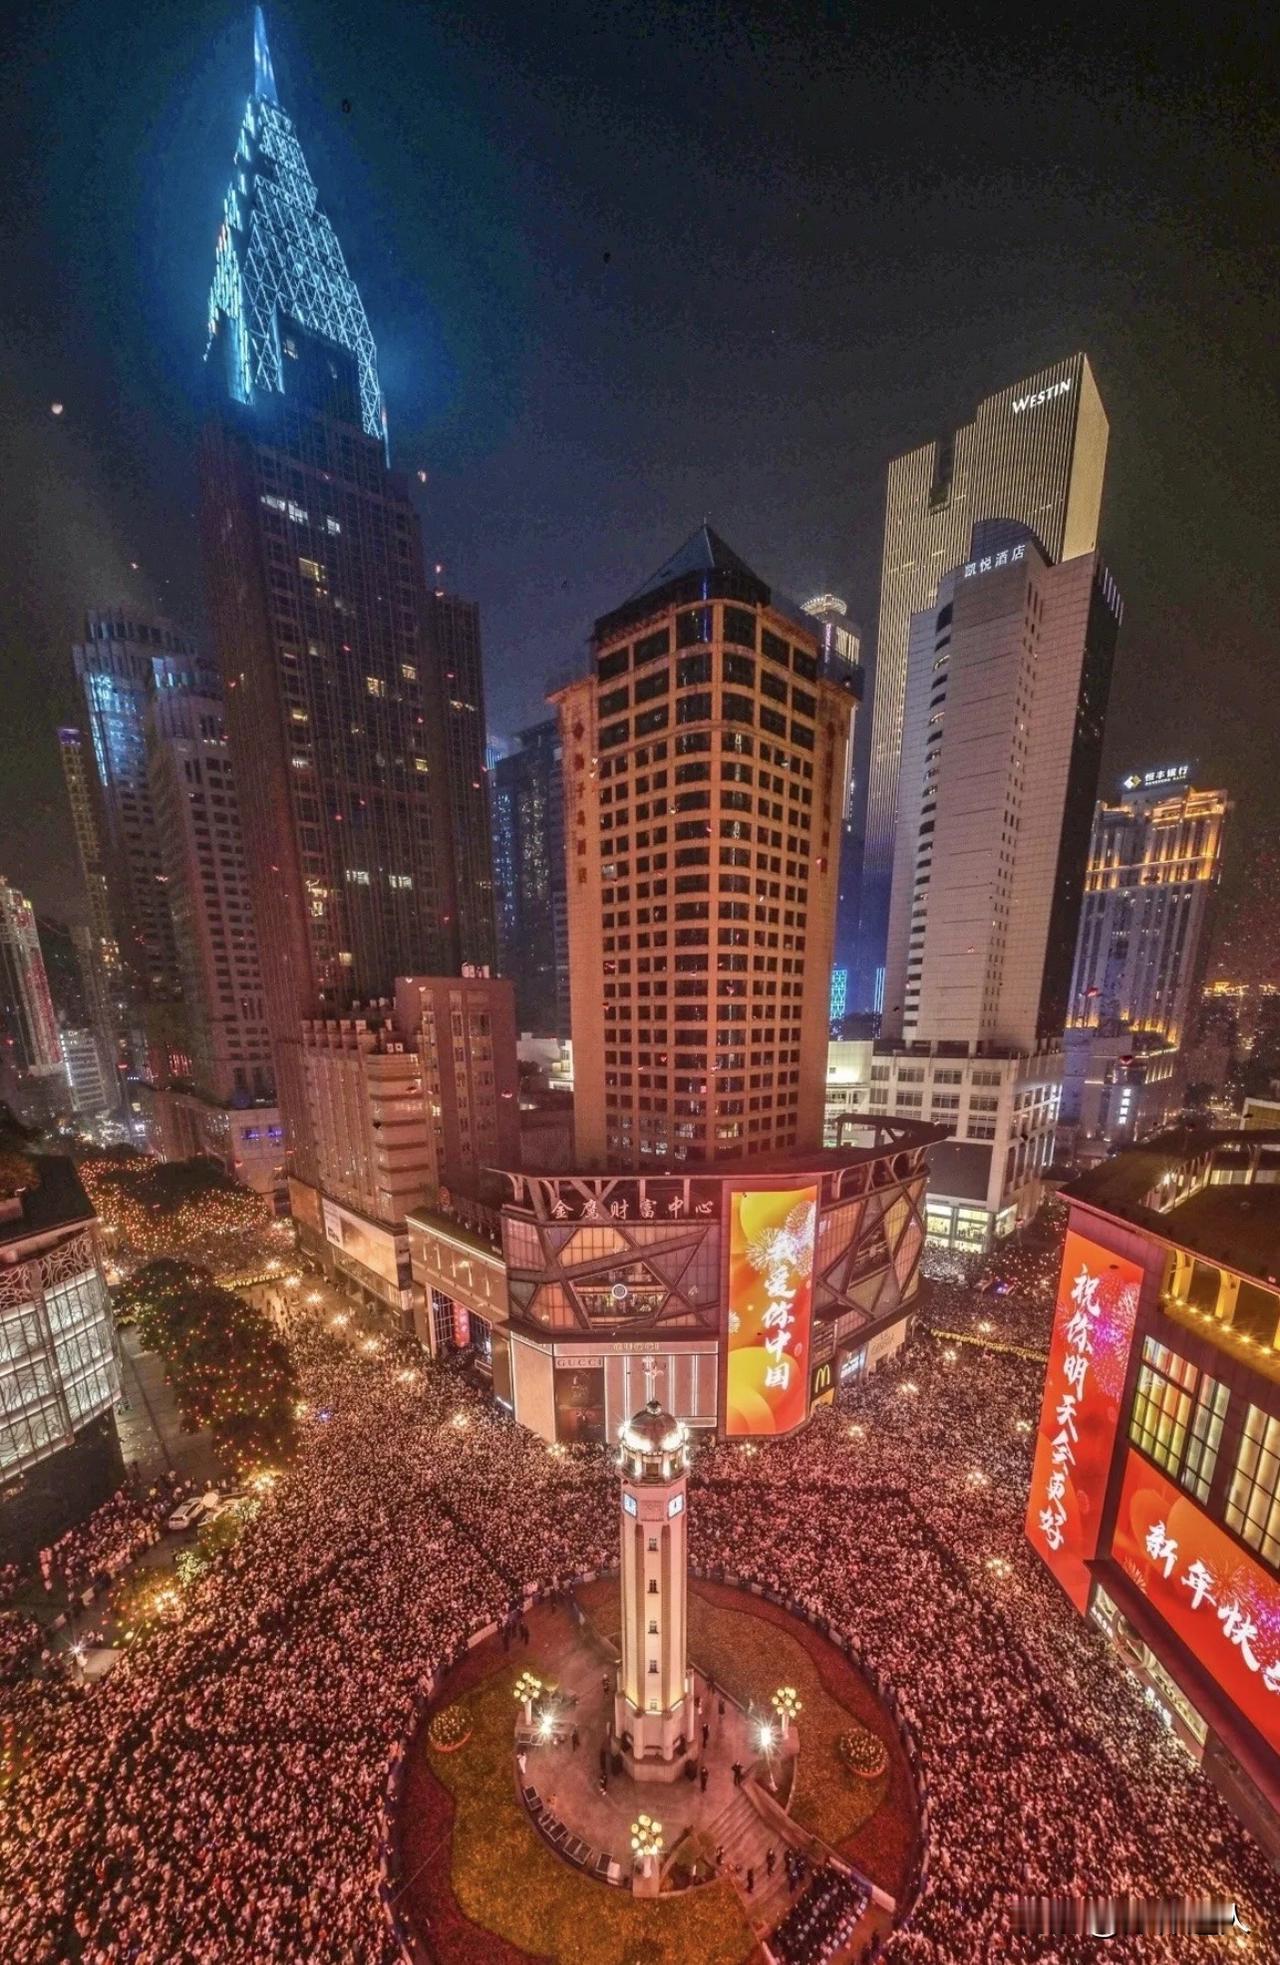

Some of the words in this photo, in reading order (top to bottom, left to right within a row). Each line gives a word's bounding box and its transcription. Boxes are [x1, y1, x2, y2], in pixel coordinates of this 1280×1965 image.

[1012, 378, 1071, 414] WESTIN
[964, 545, 1026, 578] 凯悦酒店
[551, 1195, 714, 1219] 金鹰财富中心
[556, 1359, 603, 1368] GUCCI
